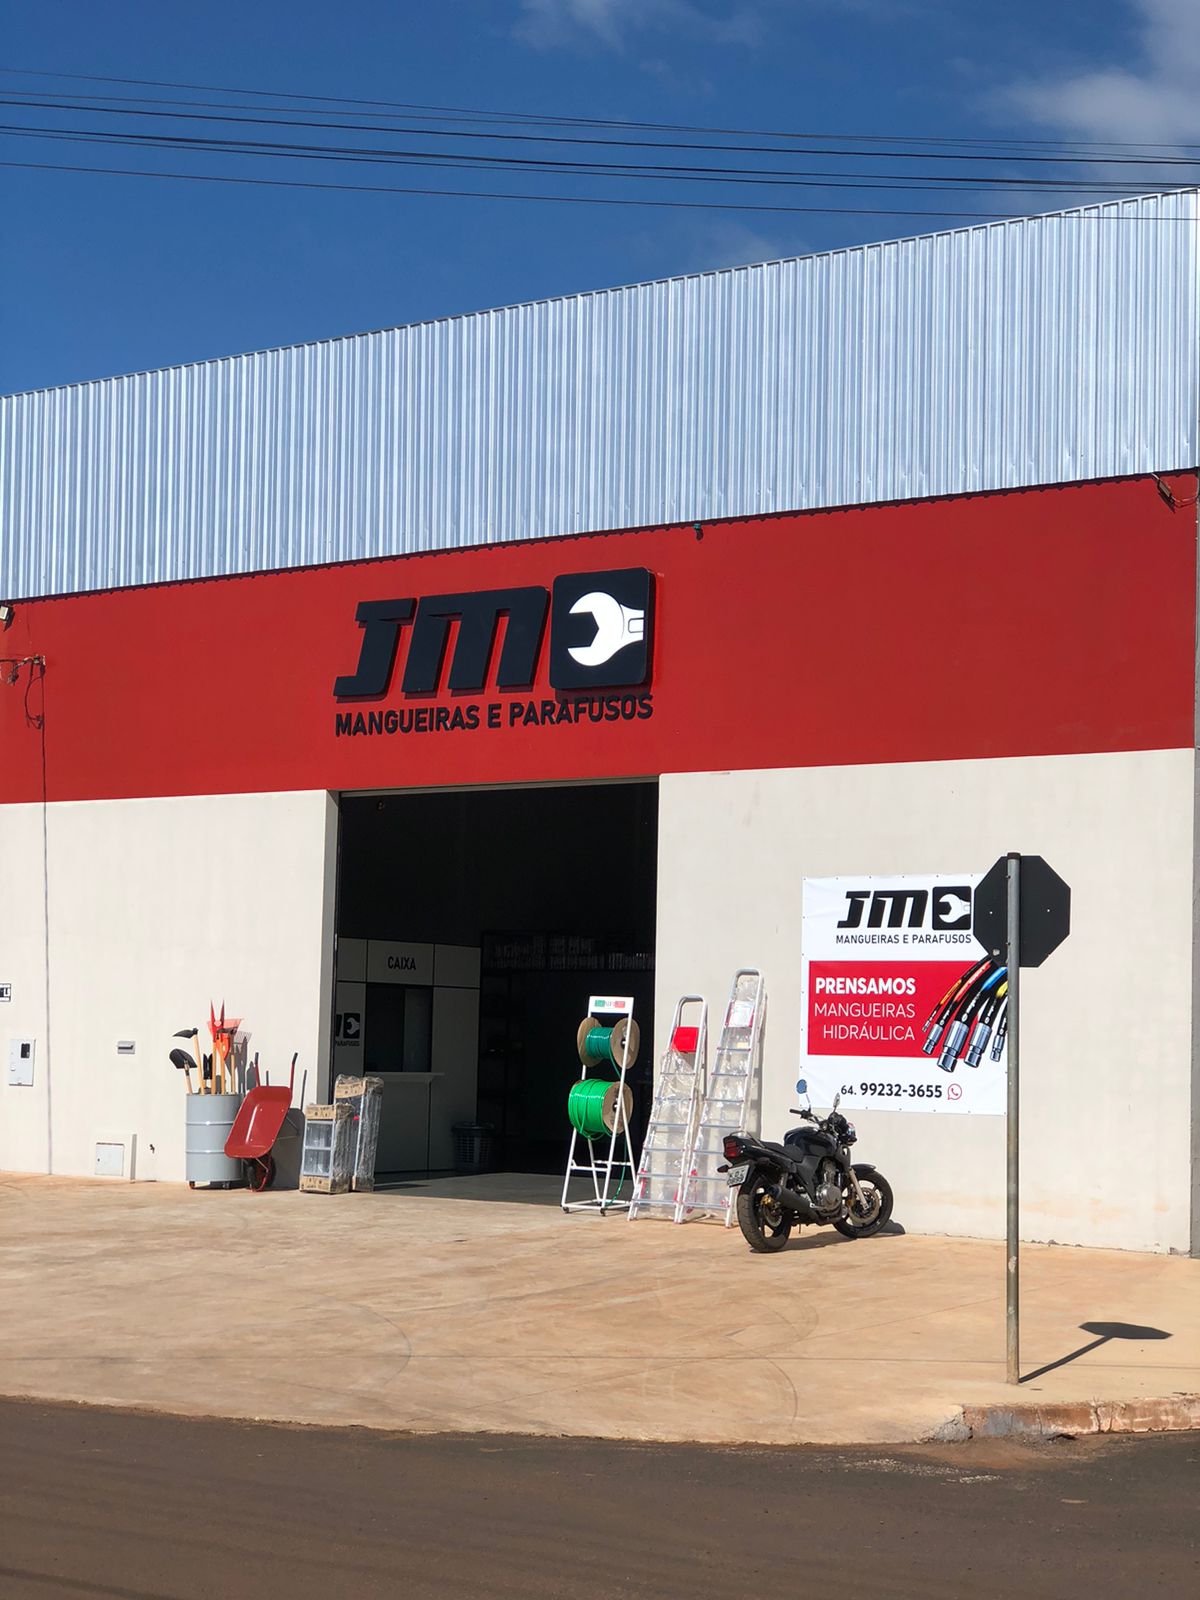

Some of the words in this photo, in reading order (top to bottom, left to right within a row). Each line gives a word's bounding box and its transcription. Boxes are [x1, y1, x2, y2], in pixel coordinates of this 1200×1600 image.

[333, 586, 551, 696] JM
[335, 704, 480, 736] MANGUEIRAS
[487, 702, 502, 728] E
[509, 694, 654, 727] PARAFUSOS
[836, 889, 929, 928] JM
[836, 934, 900, 944] MANGUEIRAS
[903, 934, 909, 944] E
[912, 934, 972, 944] PARAFUSOS
[387, 956, 416, 970] CAIXA
[815, 977, 916, 995] PRENSAMOS
[814, 1002, 915, 1018] MANGUEIRAS
[823, 1021, 915, 1041] HIDRÁULICA
[840, 1085, 857, 1095] 64.
[860, 1083, 942, 1098] 99232-3655
